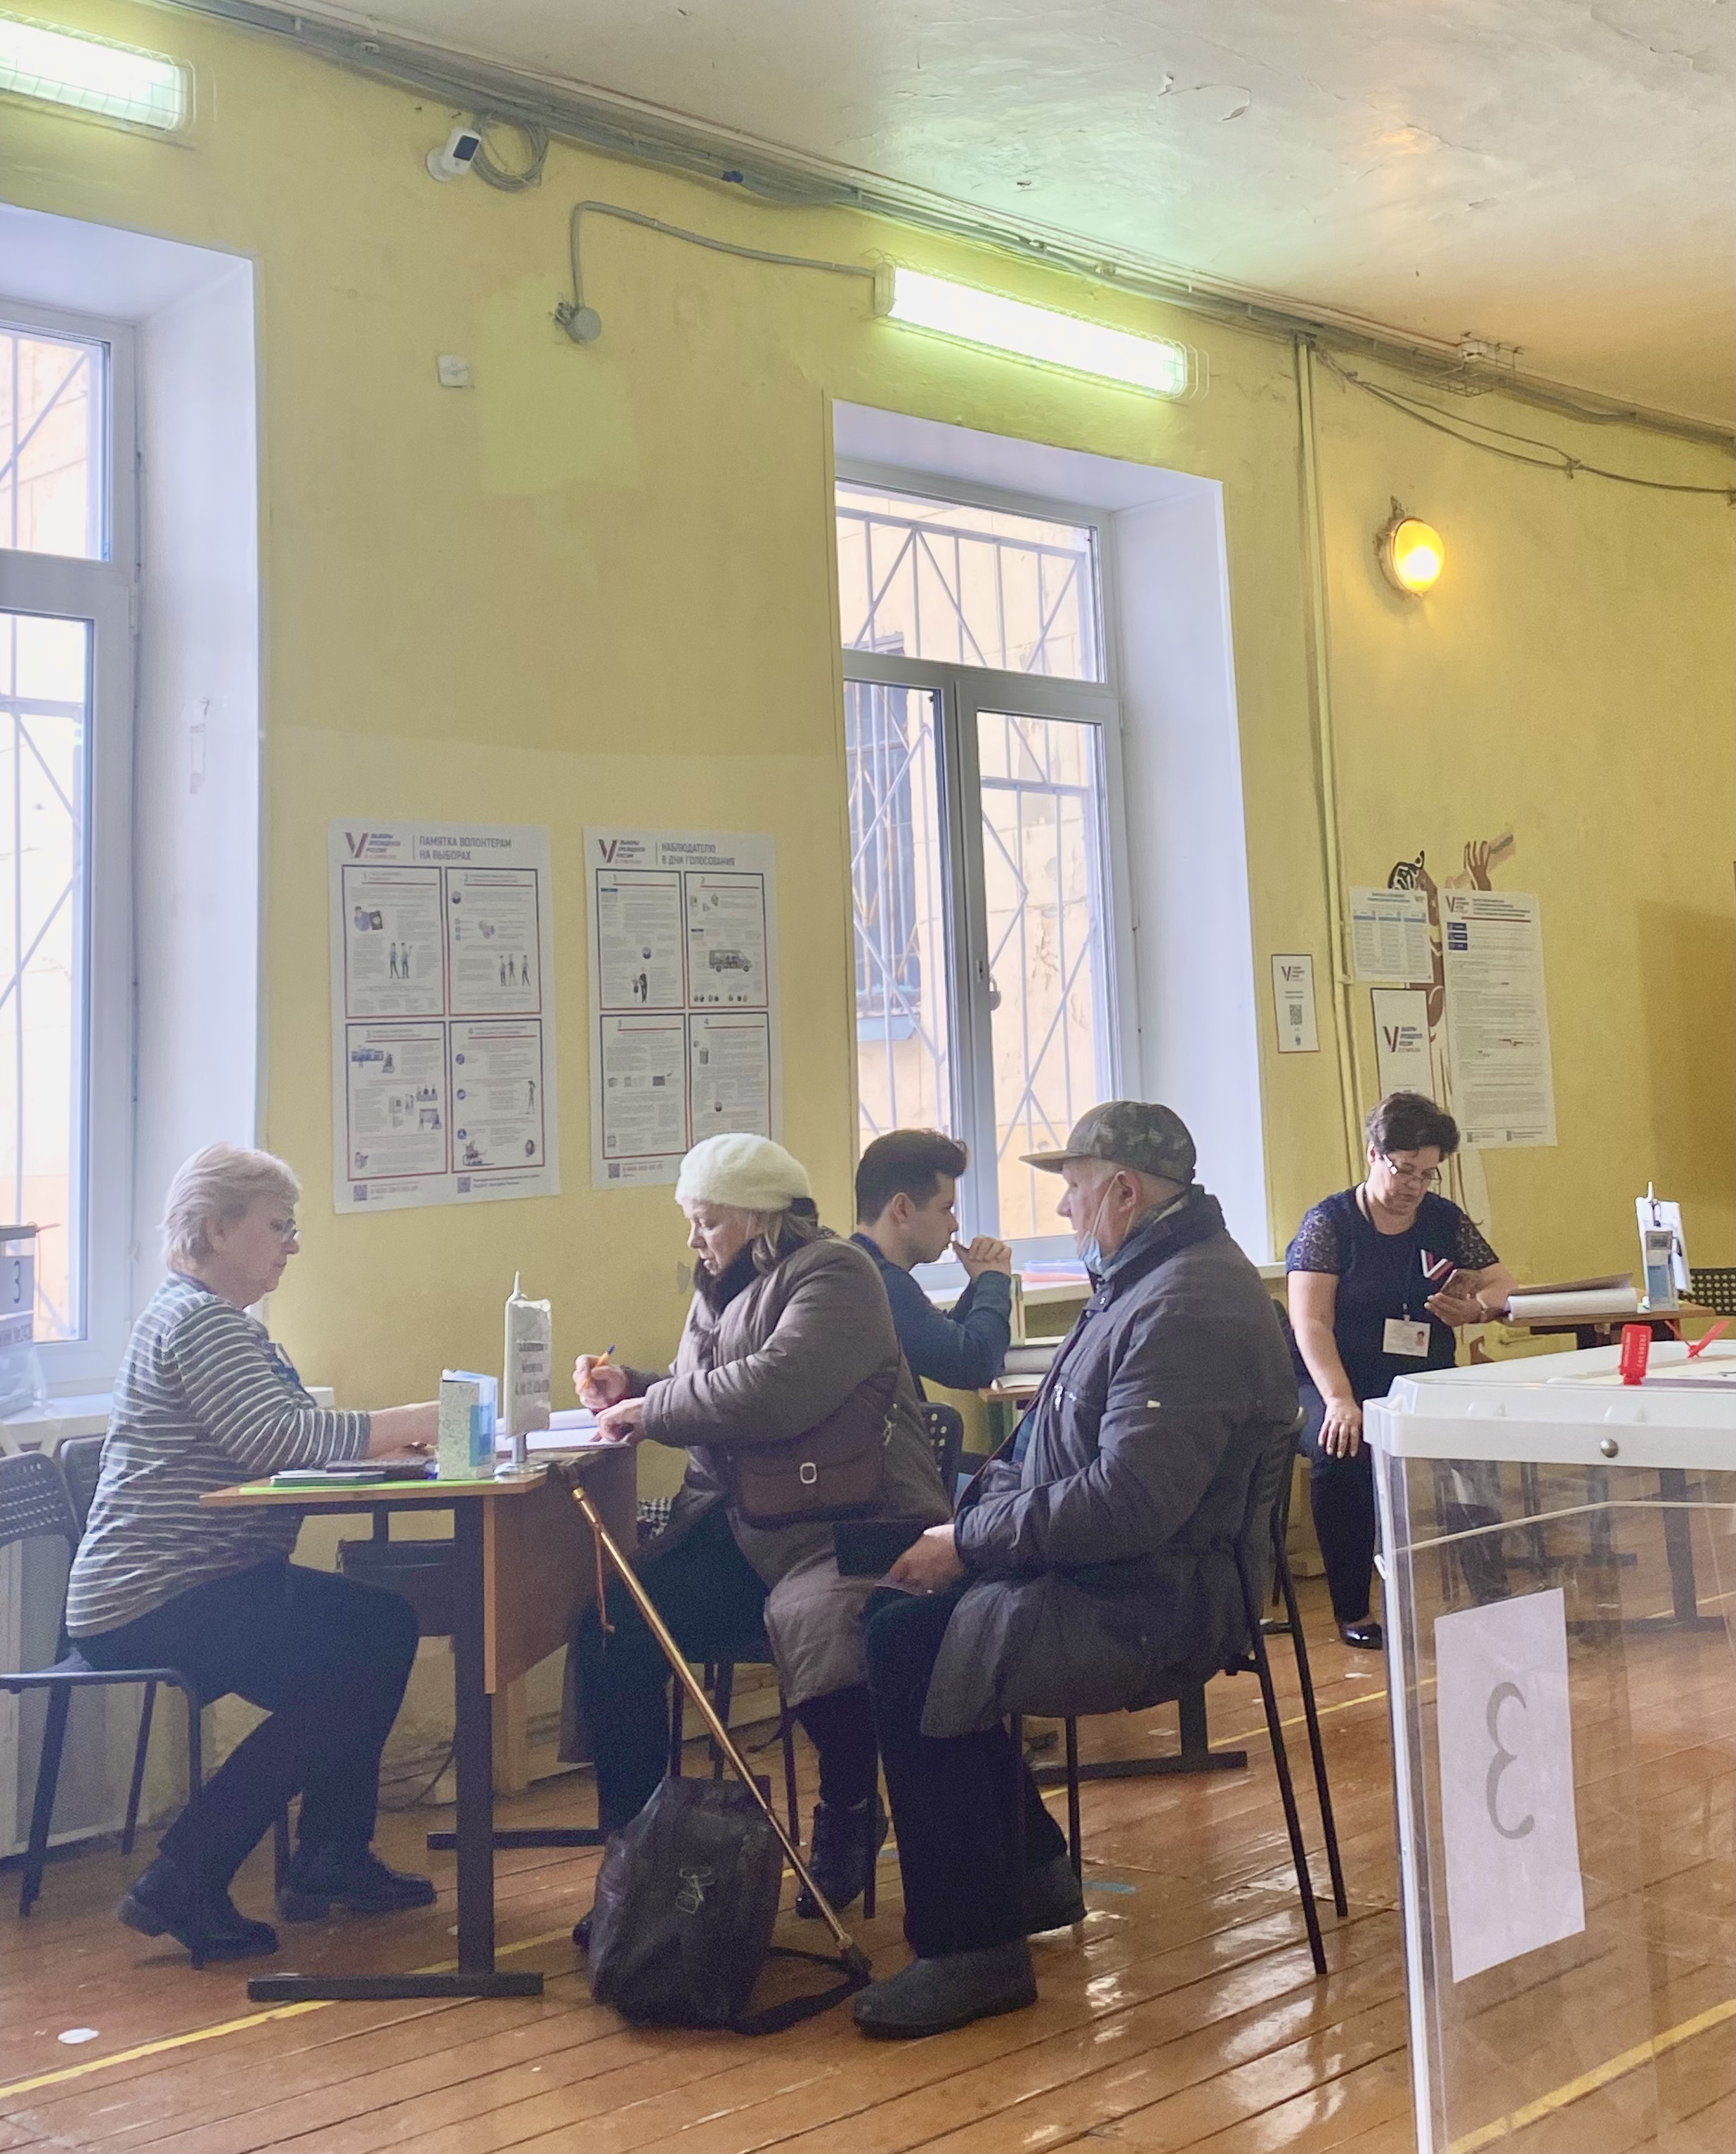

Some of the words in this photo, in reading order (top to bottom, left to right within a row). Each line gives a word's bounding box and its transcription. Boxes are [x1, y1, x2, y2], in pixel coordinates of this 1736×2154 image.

[419, 835, 457, 847] ПАМЯТКА
[459, 837, 512, 849] ВОЛОНТЕРАМ
[661, 842, 716, 853] НАБЛЮДАТЕЛЮ
[419, 849, 431, 859] НА
[433, 850, 471, 861] ВЫБОРАХ
[662, 855, 667, 864] В
[669, 855, 684, 865] ДНИ
[685, 856, 736, 866] ГОЛОСОВАНИЯ
[13, 1260, 22, 1305] 3
